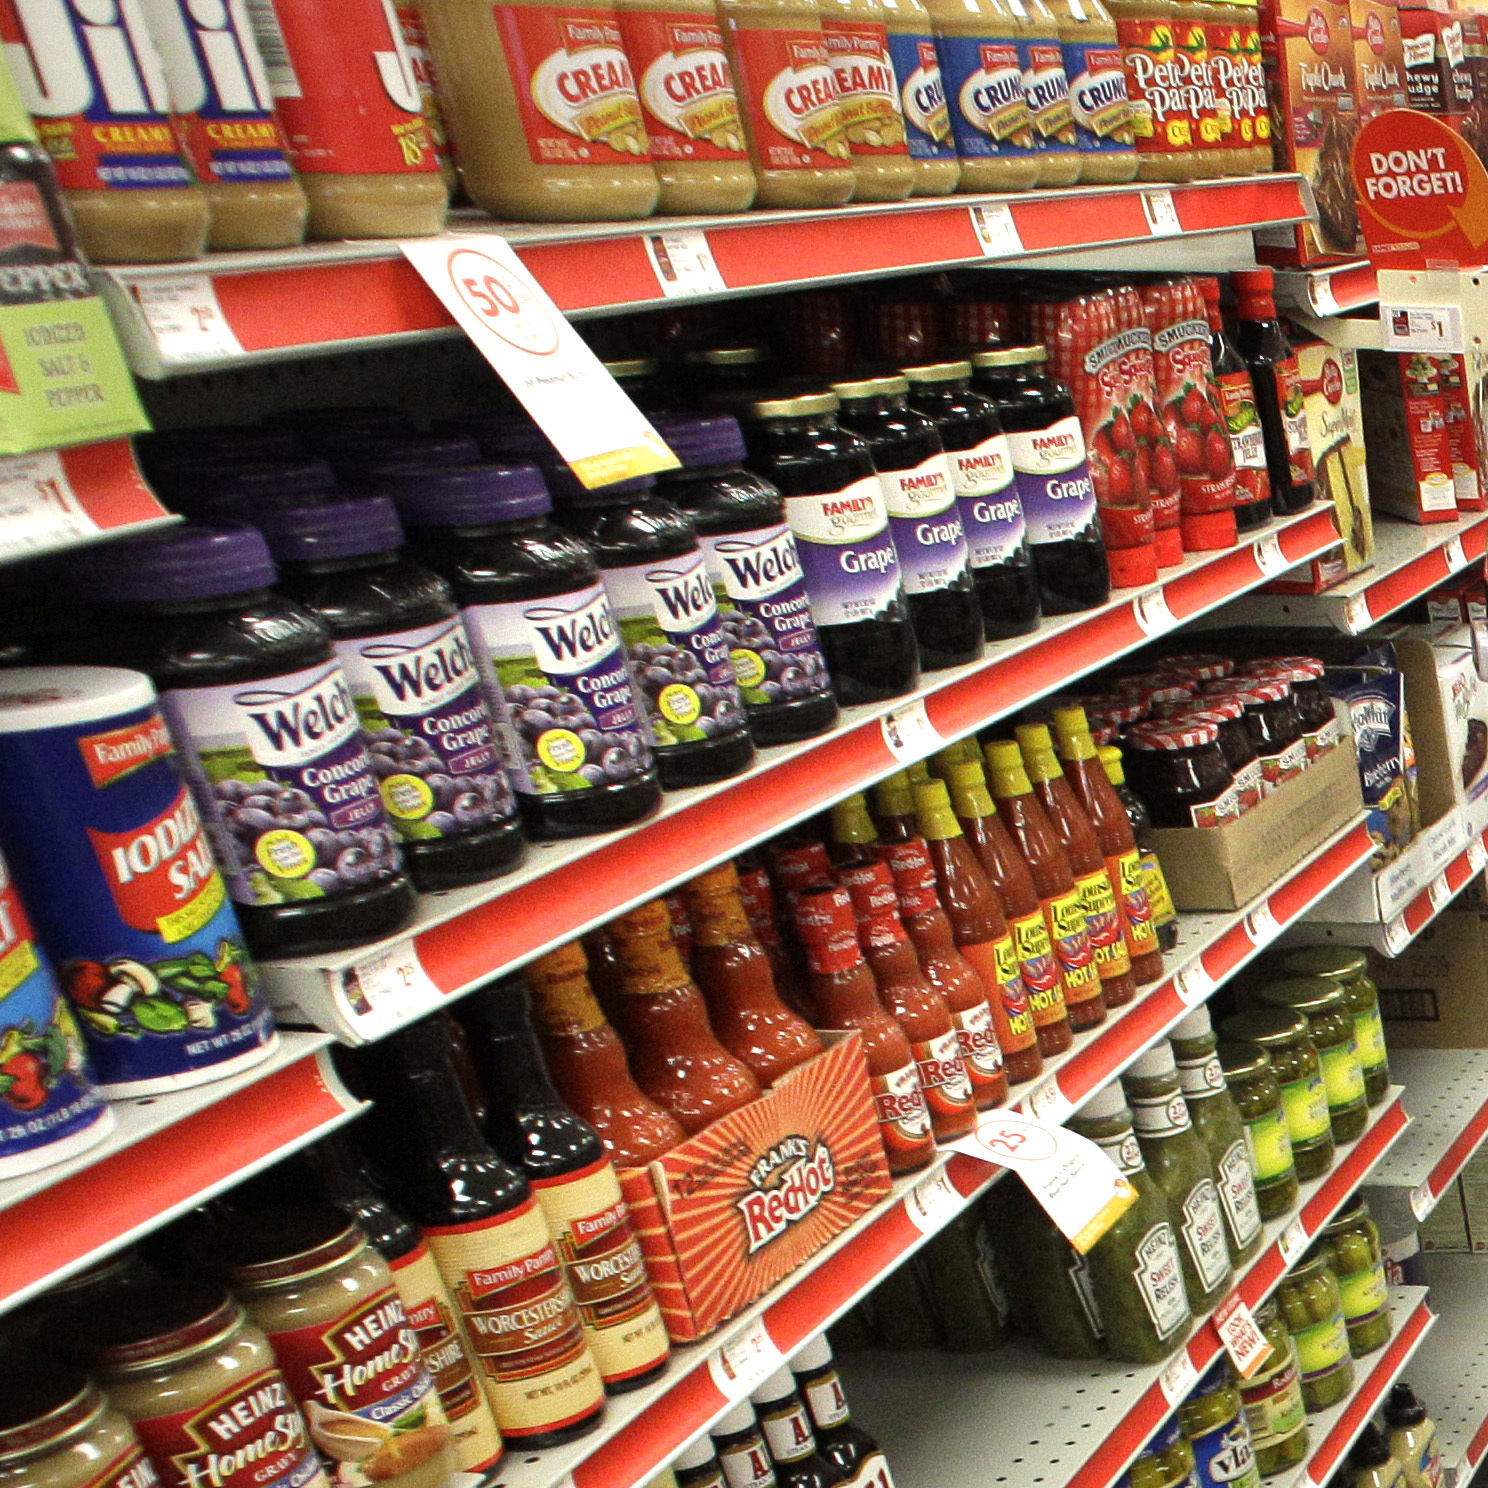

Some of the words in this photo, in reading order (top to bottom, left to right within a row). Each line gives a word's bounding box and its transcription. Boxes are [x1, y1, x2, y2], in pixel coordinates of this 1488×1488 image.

[1370, 147, 1447, 173] DON'T
[1365, 171, 1464, 199] FORGET!
[462, 277, 520, 317] 50
[738, 1147, 836, 1253] RedHot
[208, 1383, 289, 1438] HEINZ
